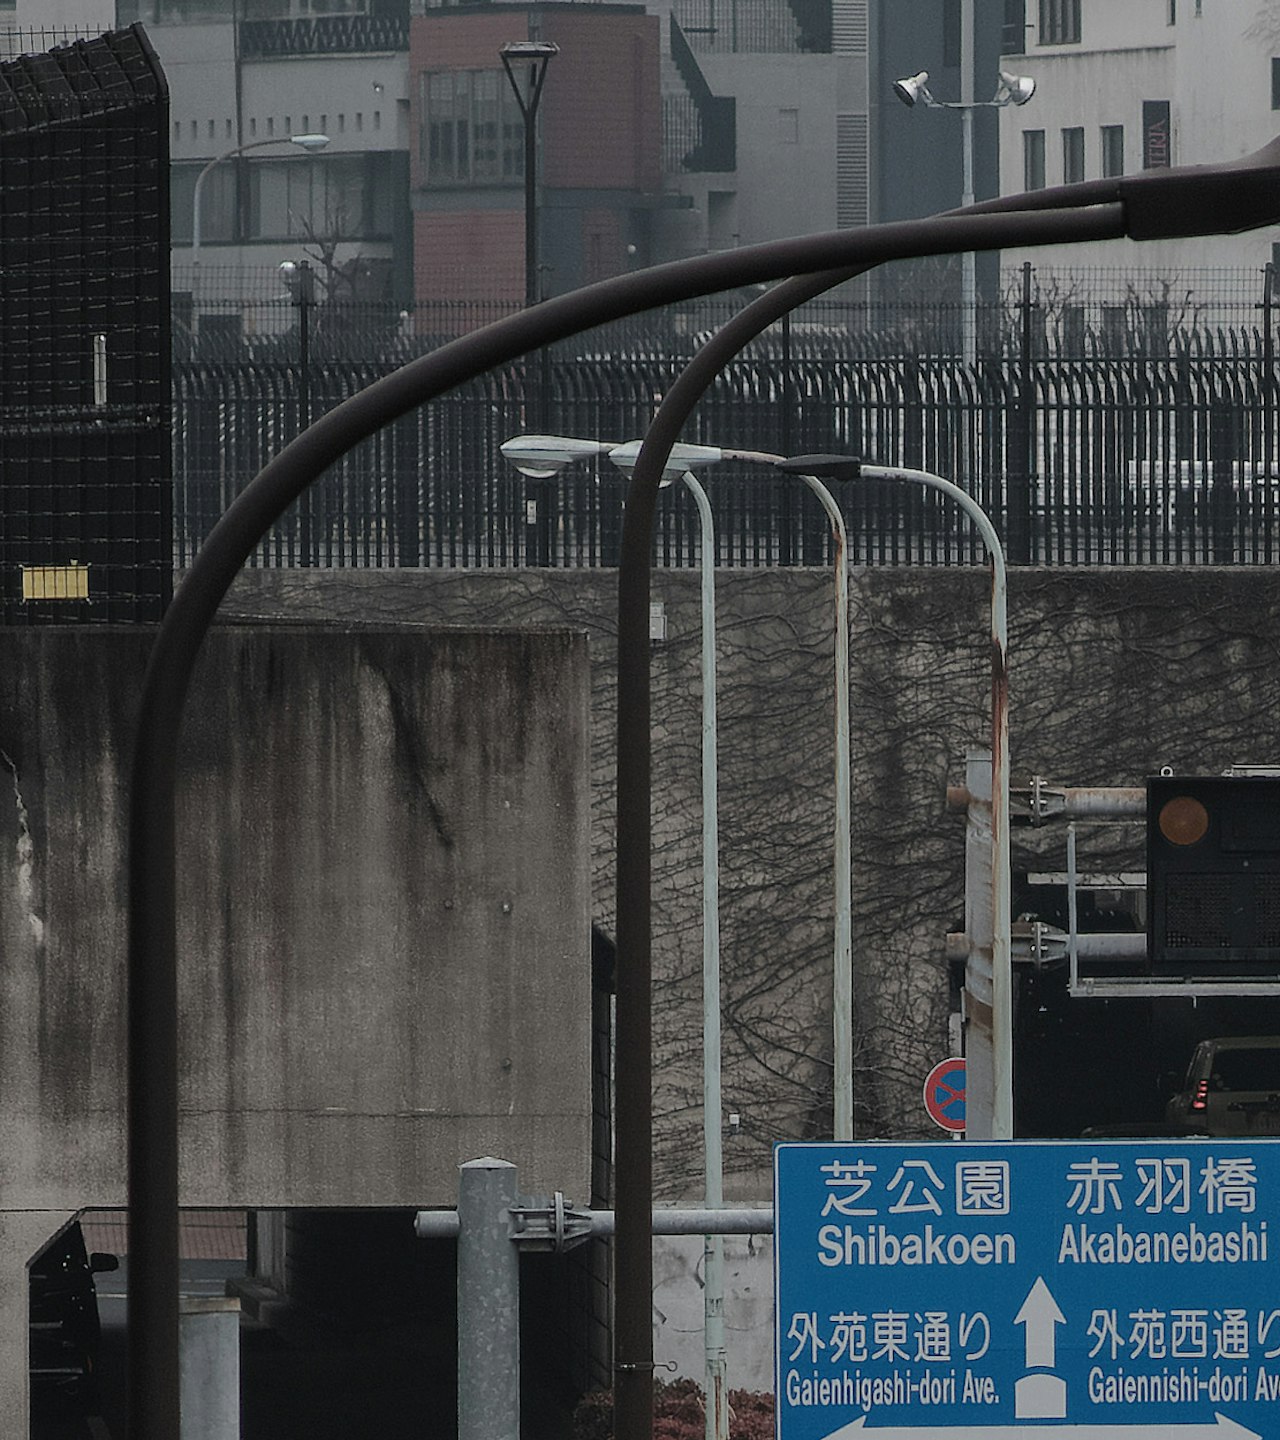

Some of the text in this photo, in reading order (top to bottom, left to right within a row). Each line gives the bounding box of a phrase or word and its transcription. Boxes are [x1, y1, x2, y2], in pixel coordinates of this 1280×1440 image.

[819, 1155, 1259, 1218] 芝公園 赤羽橋
[816, 1221, 1269, 1267] Shibakoen Akabanebashi
[786, 1310, 993, 1365] 外苑東通り
[786, 1369, 1000, 1413] Gaienhigashi-dori Ave.
[1088, 1365, 1249, 1404] Gaiennishi-dori
